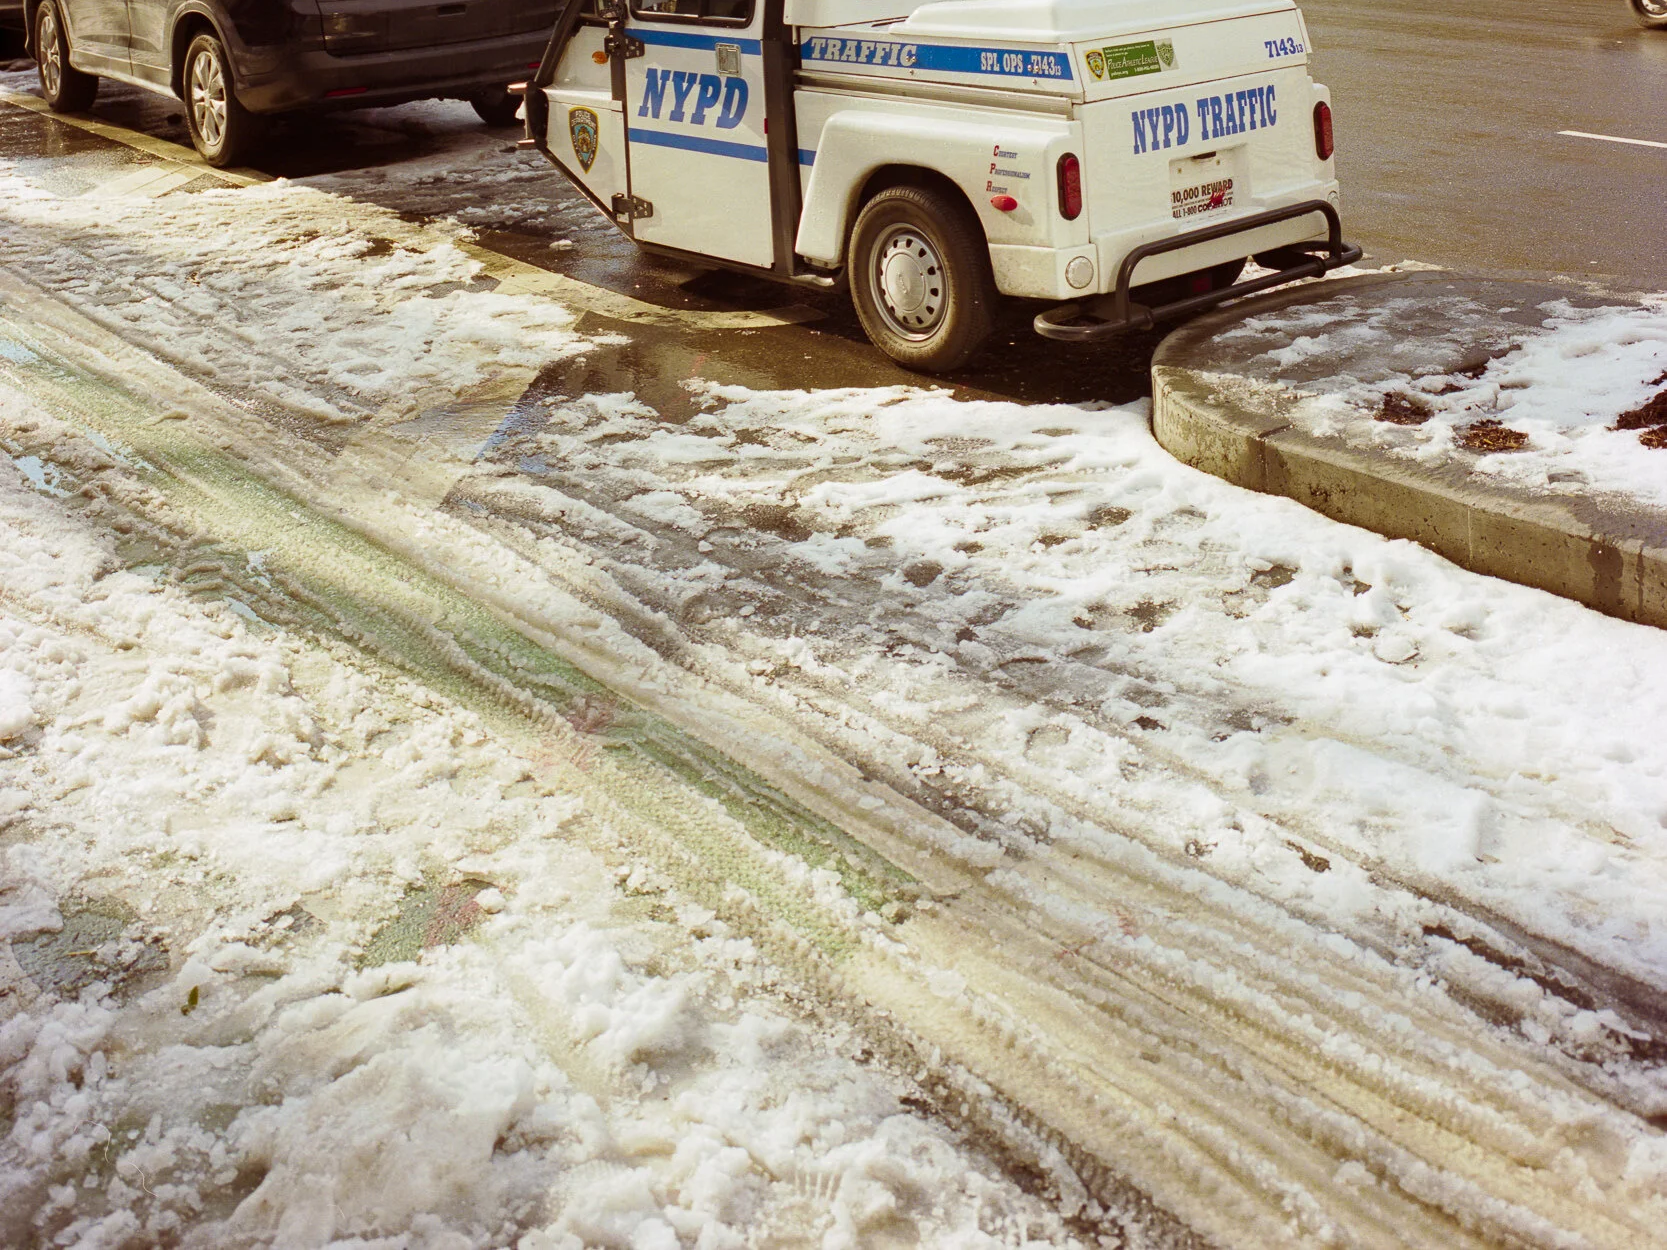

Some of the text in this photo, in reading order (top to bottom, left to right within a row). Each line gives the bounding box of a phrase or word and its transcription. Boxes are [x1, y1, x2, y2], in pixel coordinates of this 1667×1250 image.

[810, 38, 917, 67] TRAFFIC
[980, 52, 1000, 72] SPL
[1003, 54, 1023, 73] OPS
[638, 67, 749, 130] NYPD
[1131, 84, 1277, 155] NYPD TRAFFIC
[1201, 178, 1233, 196] REWARD
